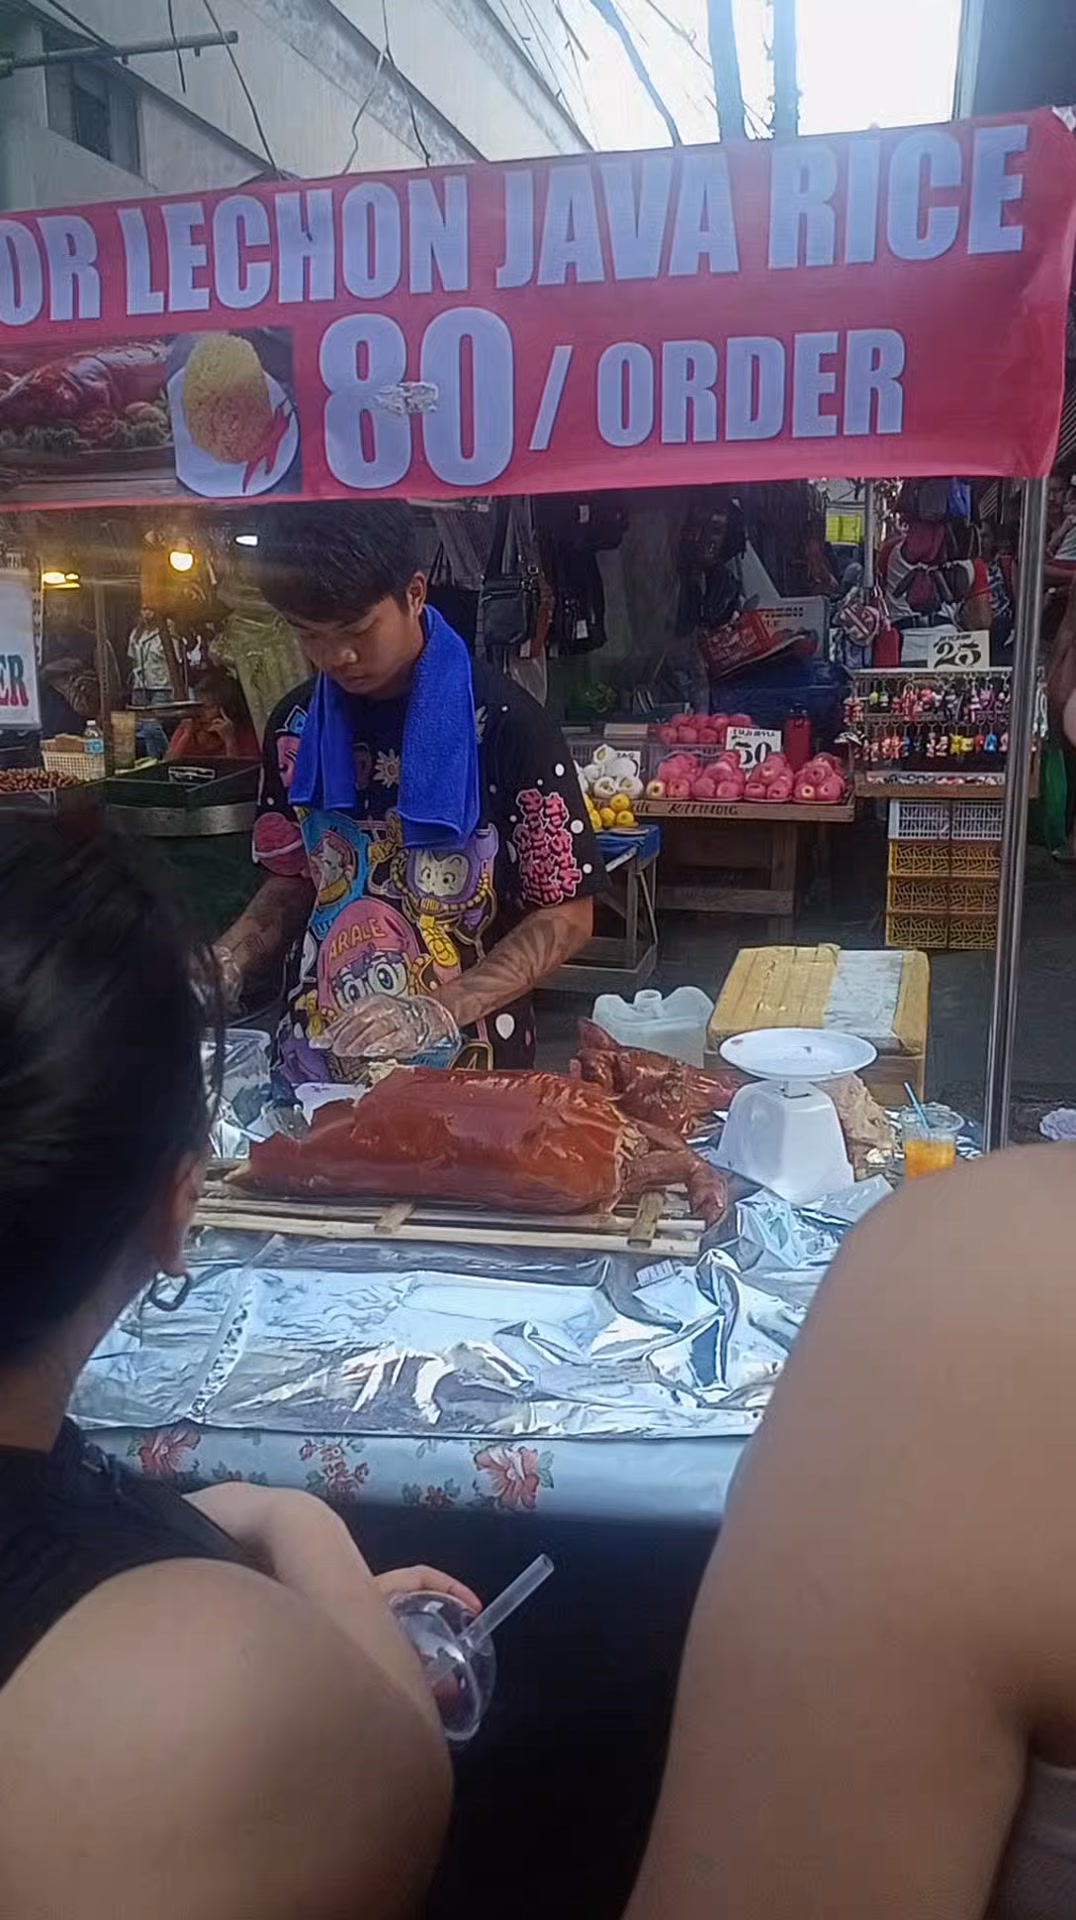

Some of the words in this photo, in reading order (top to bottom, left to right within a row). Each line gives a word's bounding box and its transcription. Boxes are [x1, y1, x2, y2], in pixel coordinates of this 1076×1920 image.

[117, 174, 469, 316] LECHON
[496, 149, 740, 289] JAVA
[768, 125, 1029, 271] RICE
[319, 307, 515, 490] 80
[597, 328, 906, 448] ORDER
[933, 642, 982, 669] 25
[733, 741, 772, 765] 50
[329, 917, 387, 963] ARALE
